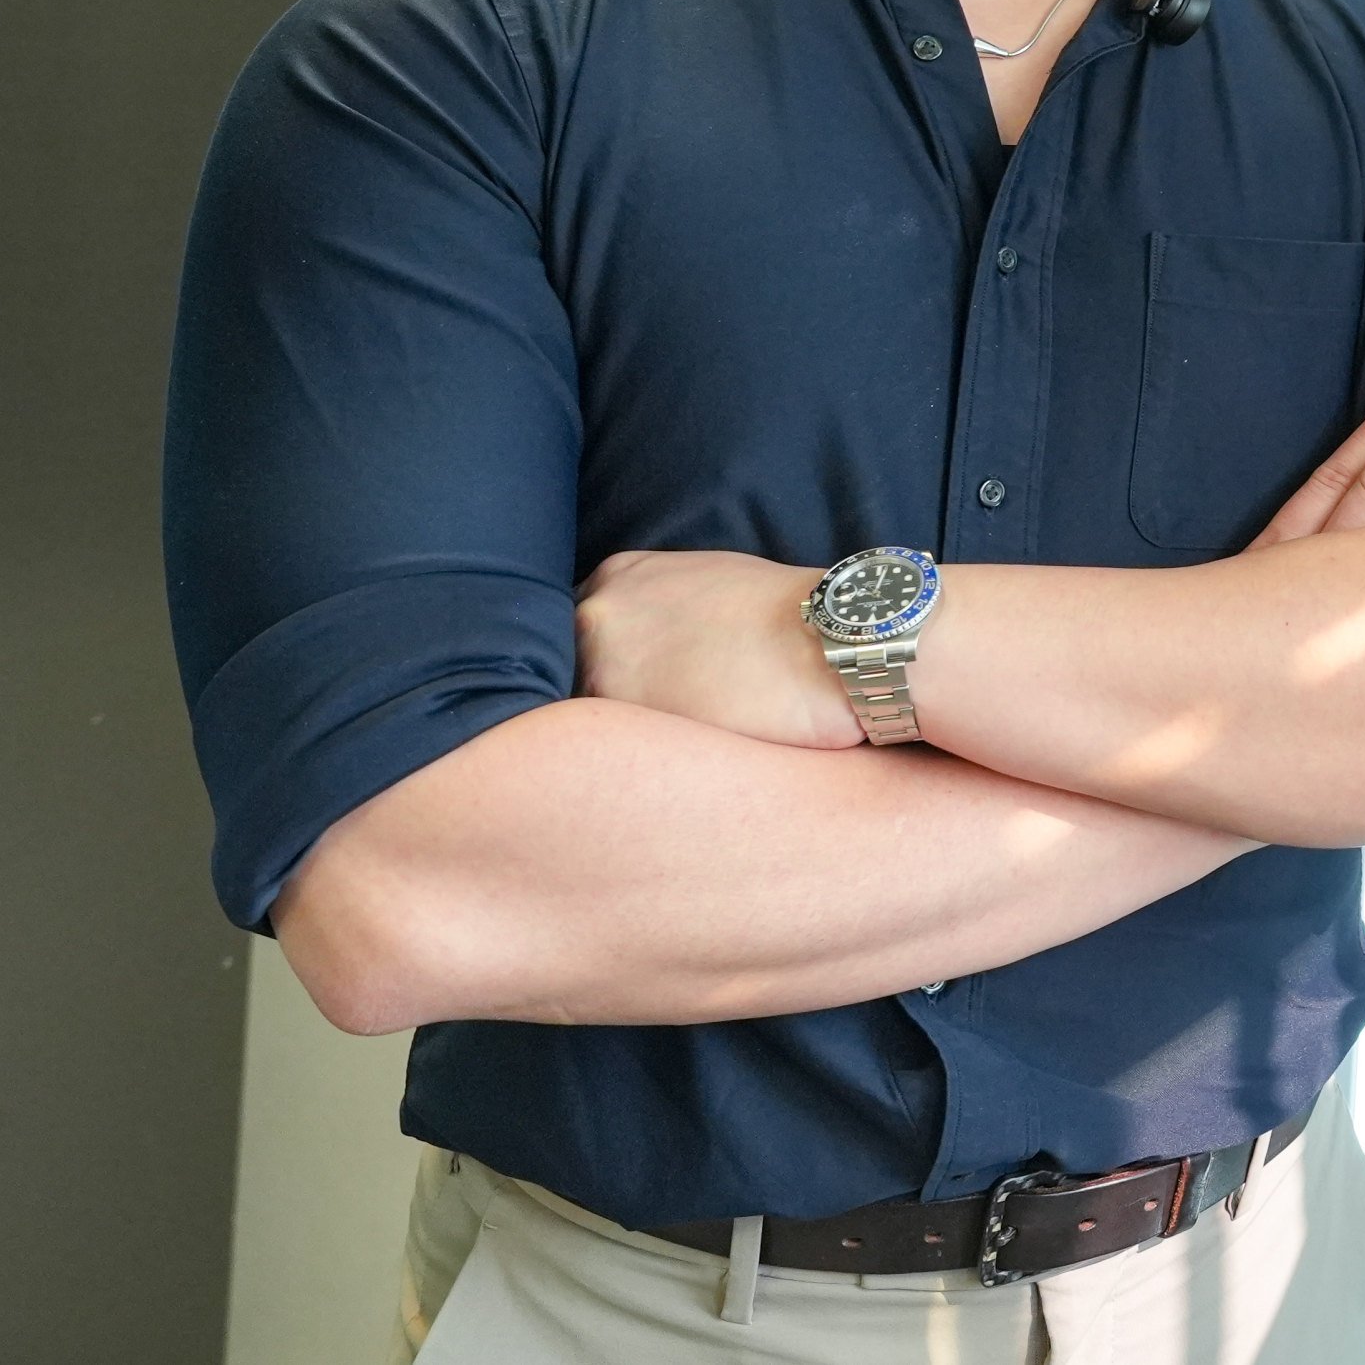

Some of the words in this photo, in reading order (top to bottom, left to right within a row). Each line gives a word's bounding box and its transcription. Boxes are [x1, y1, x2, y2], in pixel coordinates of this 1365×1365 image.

[925, 579, 936, 590] 12
[913, 597, 928, 610] 14
[816, 609, 831, 625] 22
[890, 615, 907, 627] 16
[831, 622, 850, 635] 20
[861, 625, 879, 635] 18
